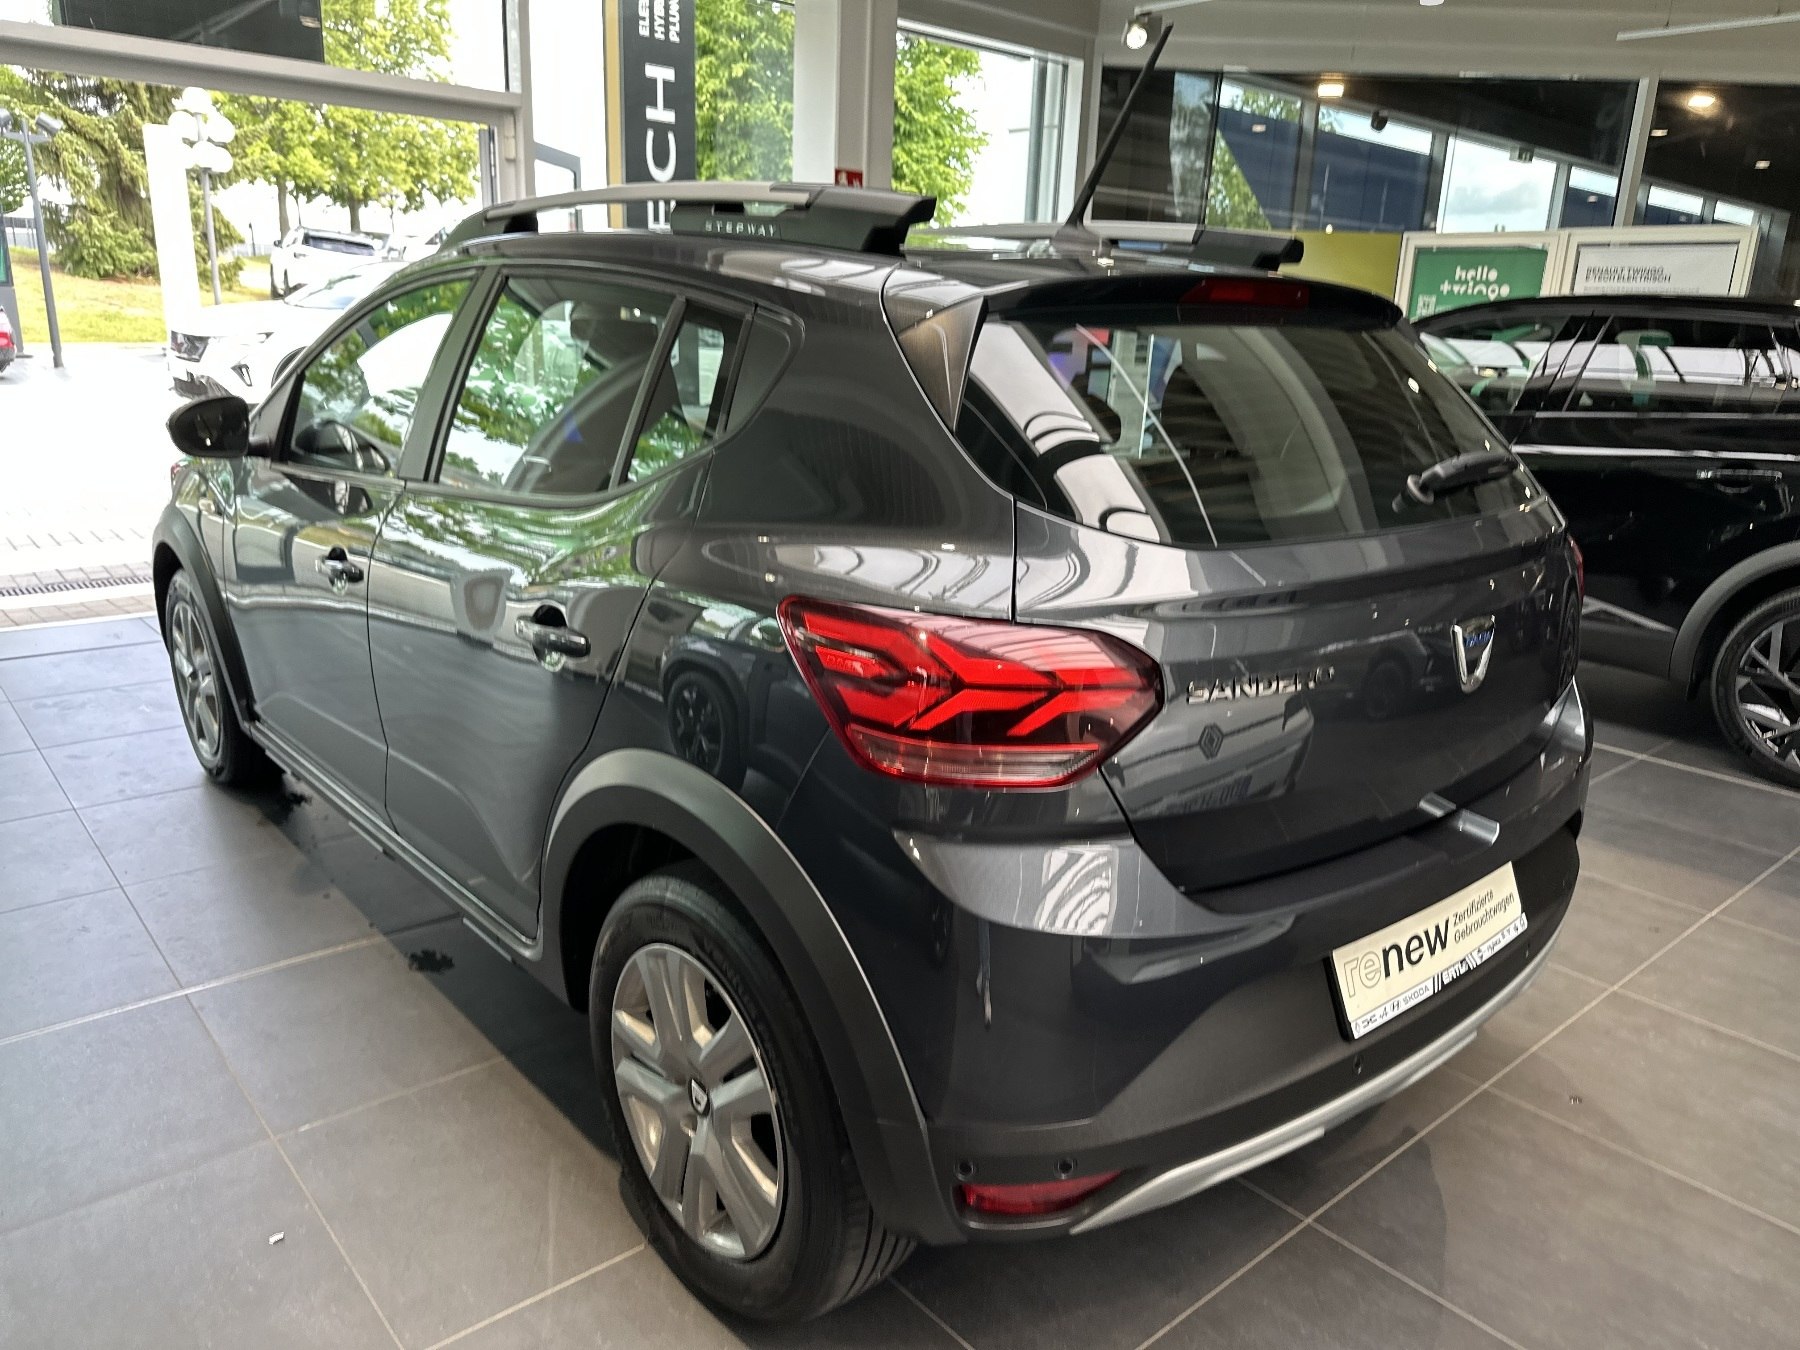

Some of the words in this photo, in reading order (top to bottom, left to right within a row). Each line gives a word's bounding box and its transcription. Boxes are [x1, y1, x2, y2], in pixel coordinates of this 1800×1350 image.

[1455, 265, 1498, 281] hello
[1453, 889, 1494, 927] Zertifizierte
[1455, 892, 1514, 944] Gebrauchtwagen
[1344, 916, 1449, 998] renew
